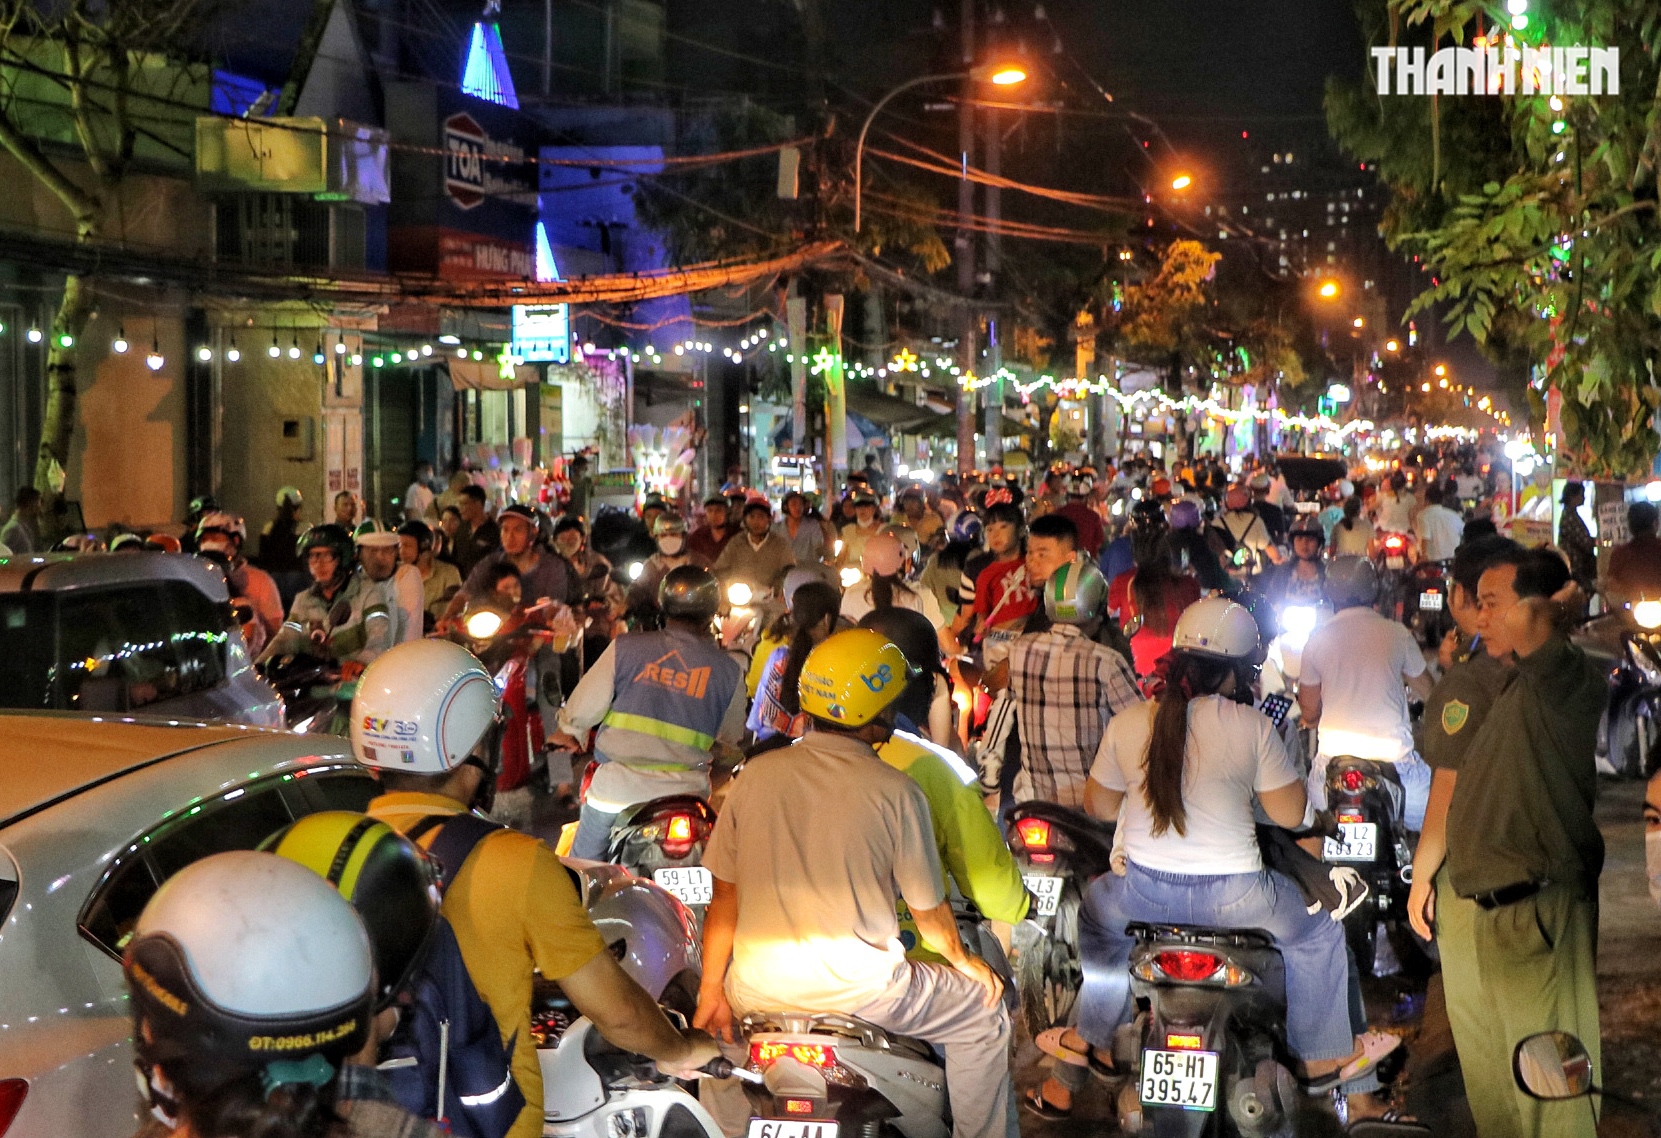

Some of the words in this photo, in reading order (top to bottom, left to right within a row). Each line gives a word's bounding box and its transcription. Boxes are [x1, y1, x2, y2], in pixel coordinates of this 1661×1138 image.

[449, 138, 482, 184] TOA
[860, 664, 893, 692] be
[662, 869, 703, 886] 59-L1
[1153, 1053, 1205, 1078] 65-H1
[1144, 1077, 1212, 1105] 395.47
